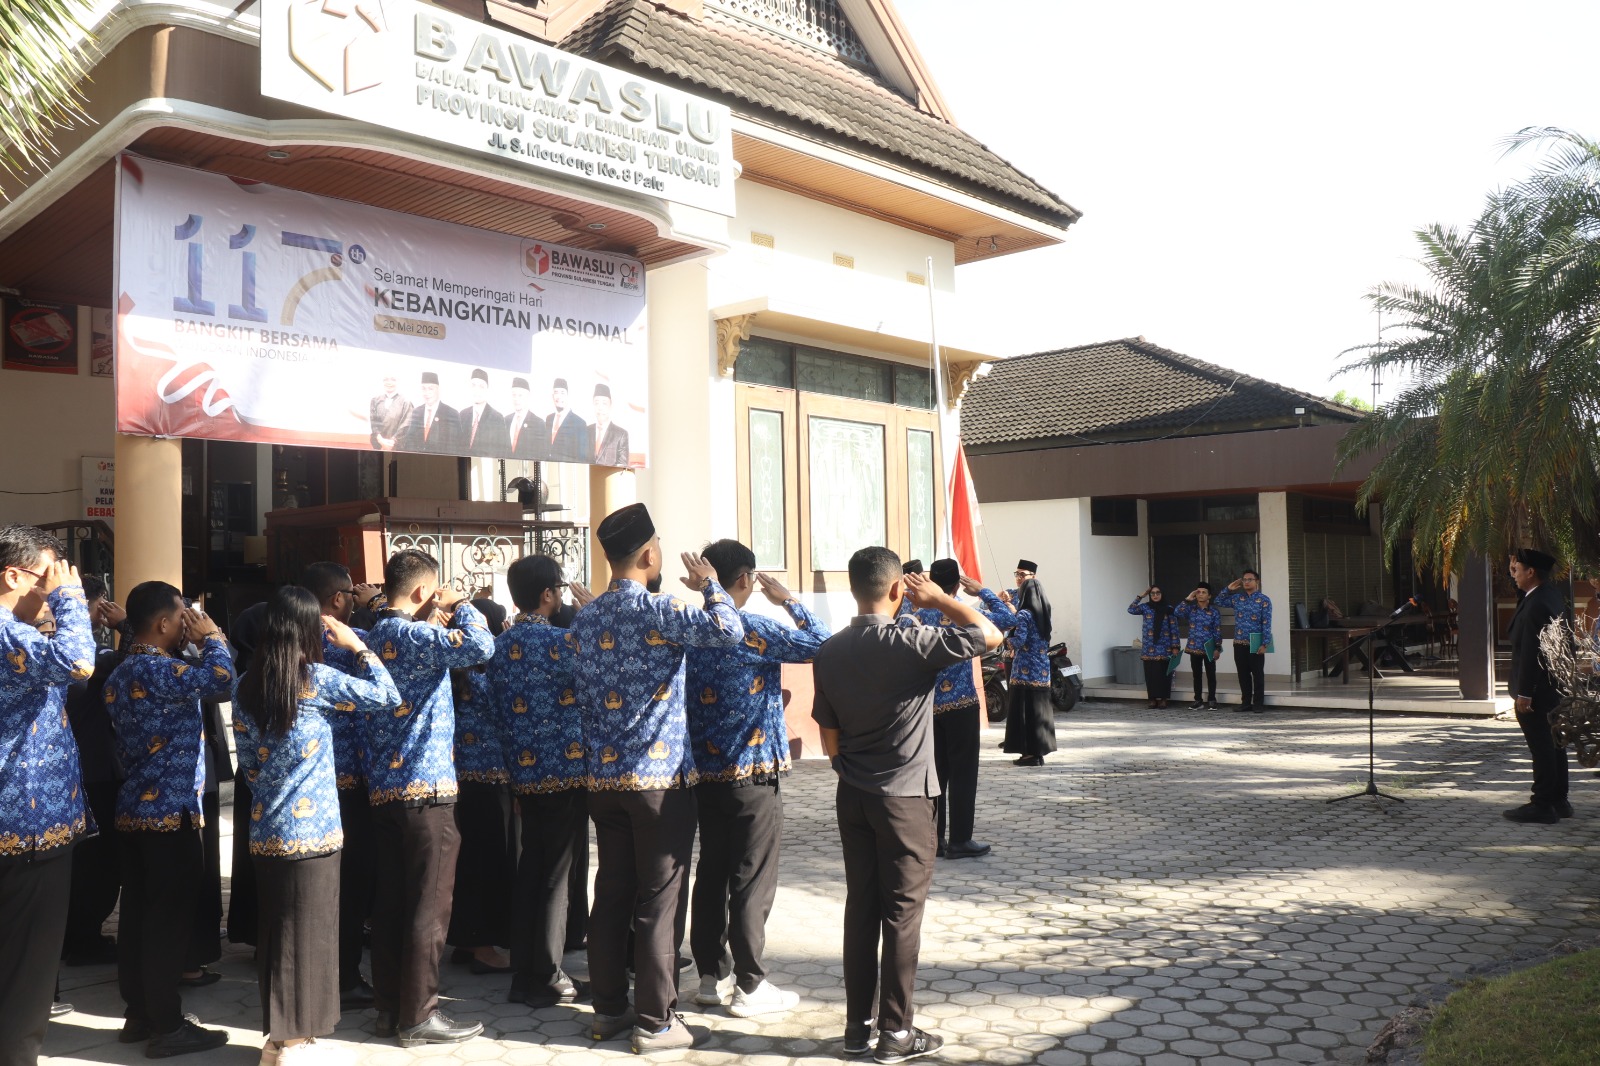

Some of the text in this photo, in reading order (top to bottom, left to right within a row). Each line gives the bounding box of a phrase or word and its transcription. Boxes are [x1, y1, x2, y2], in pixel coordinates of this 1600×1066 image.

[414, 12, 720, 144] BAWASLU
[416, 61, 720, 165] BADAN PENGAWAS PEMILIHAN UMUM
[417, 84, 720, 187] PROVINSI SULAWESI TENGAH
[634, 170, 665, 192] Palu
[173, 213, 343, 327] 117
[551, 250, 615, 275] BAWASLU
[551, 271, 574, 281] PROVINSI
[573, 276, 597, 285] SULAWESI
[374, 268, 543, 308] Selamat Memperingati Hari
[374, 286, 633, 345] KEBANGKITAN NASIONAL
[383, 319, 439, 336] 20 Mei 2025
[174, 318, 339, 351] BANGKIT BERSAMA
[246, 346, 309, 363] INDONESIA
